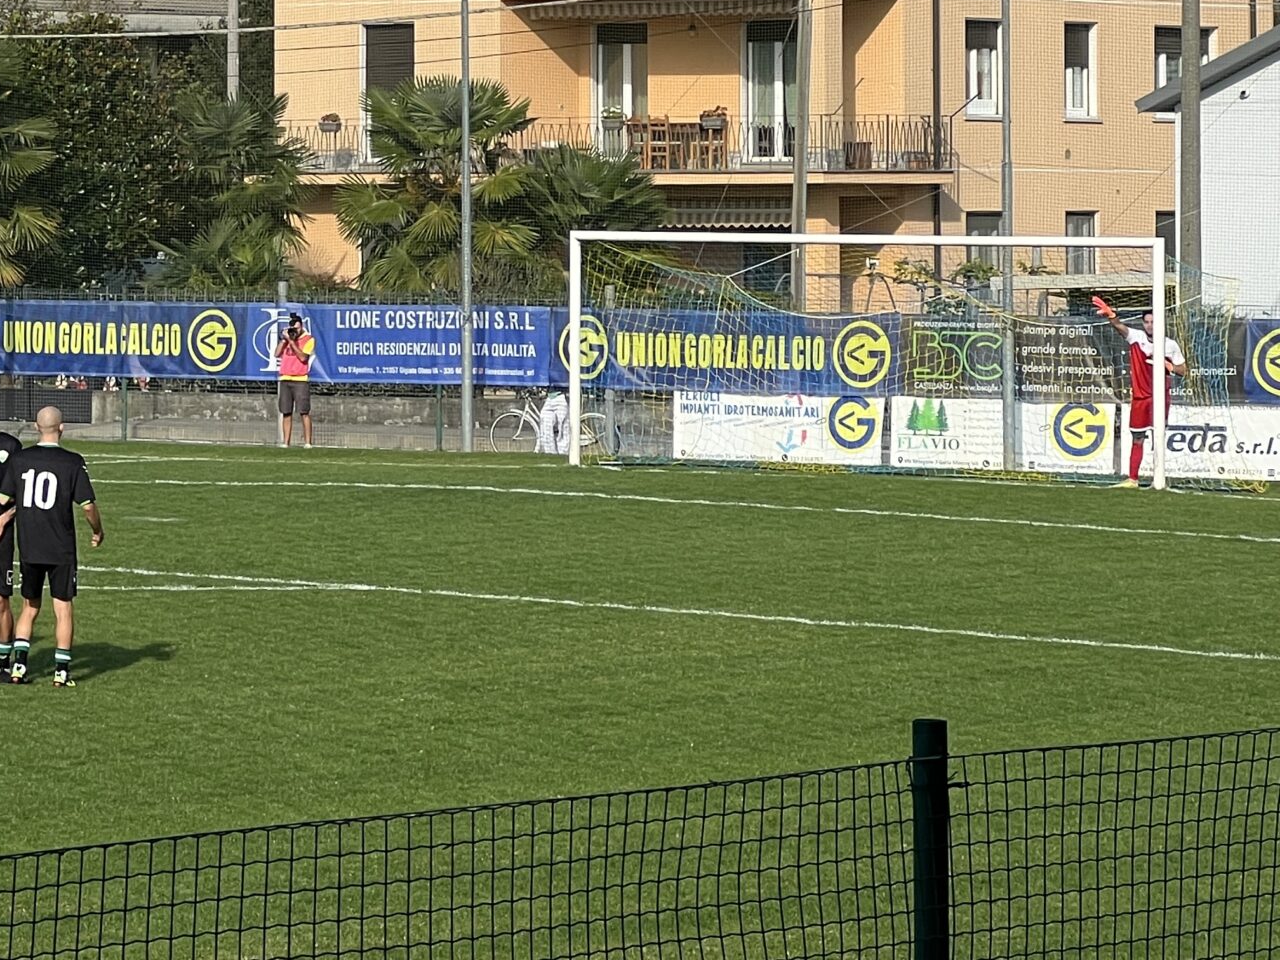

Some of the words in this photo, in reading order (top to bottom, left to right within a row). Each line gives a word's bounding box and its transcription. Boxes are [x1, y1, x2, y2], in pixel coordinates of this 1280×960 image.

[336, 310, 381, 329] LIONE
[385, 310, 489, 330] COSTRUZINI
[494, 311, 536, 331] S.R.L
[3, 320, 56, 354] UNION
[58, 321, 117, 356] GORLA
[121, 322, 181, 357] CALCIO
[1023, 325, 1056, 338] stampe
[1059, 324, 1093, 338] digitali
[336, 342, 374, 356] EDIFICI
[376, 342, 446, 357] RESIDENZIALI
[449, 342, 461, 357] DI
[469, 343, 489, 357] LTA
[491, 340, 537, 358] QUALITÀ
[616, 331, 681, 369] UNION
[684, 333, 748, 370] GORLA
[752, 334, 825, 371] CALCIO
[1022, 342, 1056, 356] grande
[1059, 342, 1097, 355] formato
[1022, 361, 1054, 373] adesivi
[1057, 364, 1113, 377] prespaziati
[1190, 364, 1237, 376] automezzi
[1021, 380, 1060, 392] elementi
[1063, 382, 1073, 392] in
[1075, 384, 1114, 395] cartone
[680, 402, 720, 416] IMPIANTI
[897, 436, 960, 451] FLAVIO
[1156, 423, 1227, 453] eda
[1235, 436, 1278, 455] s.r.l.
[21, 468, 58, 510] 10
